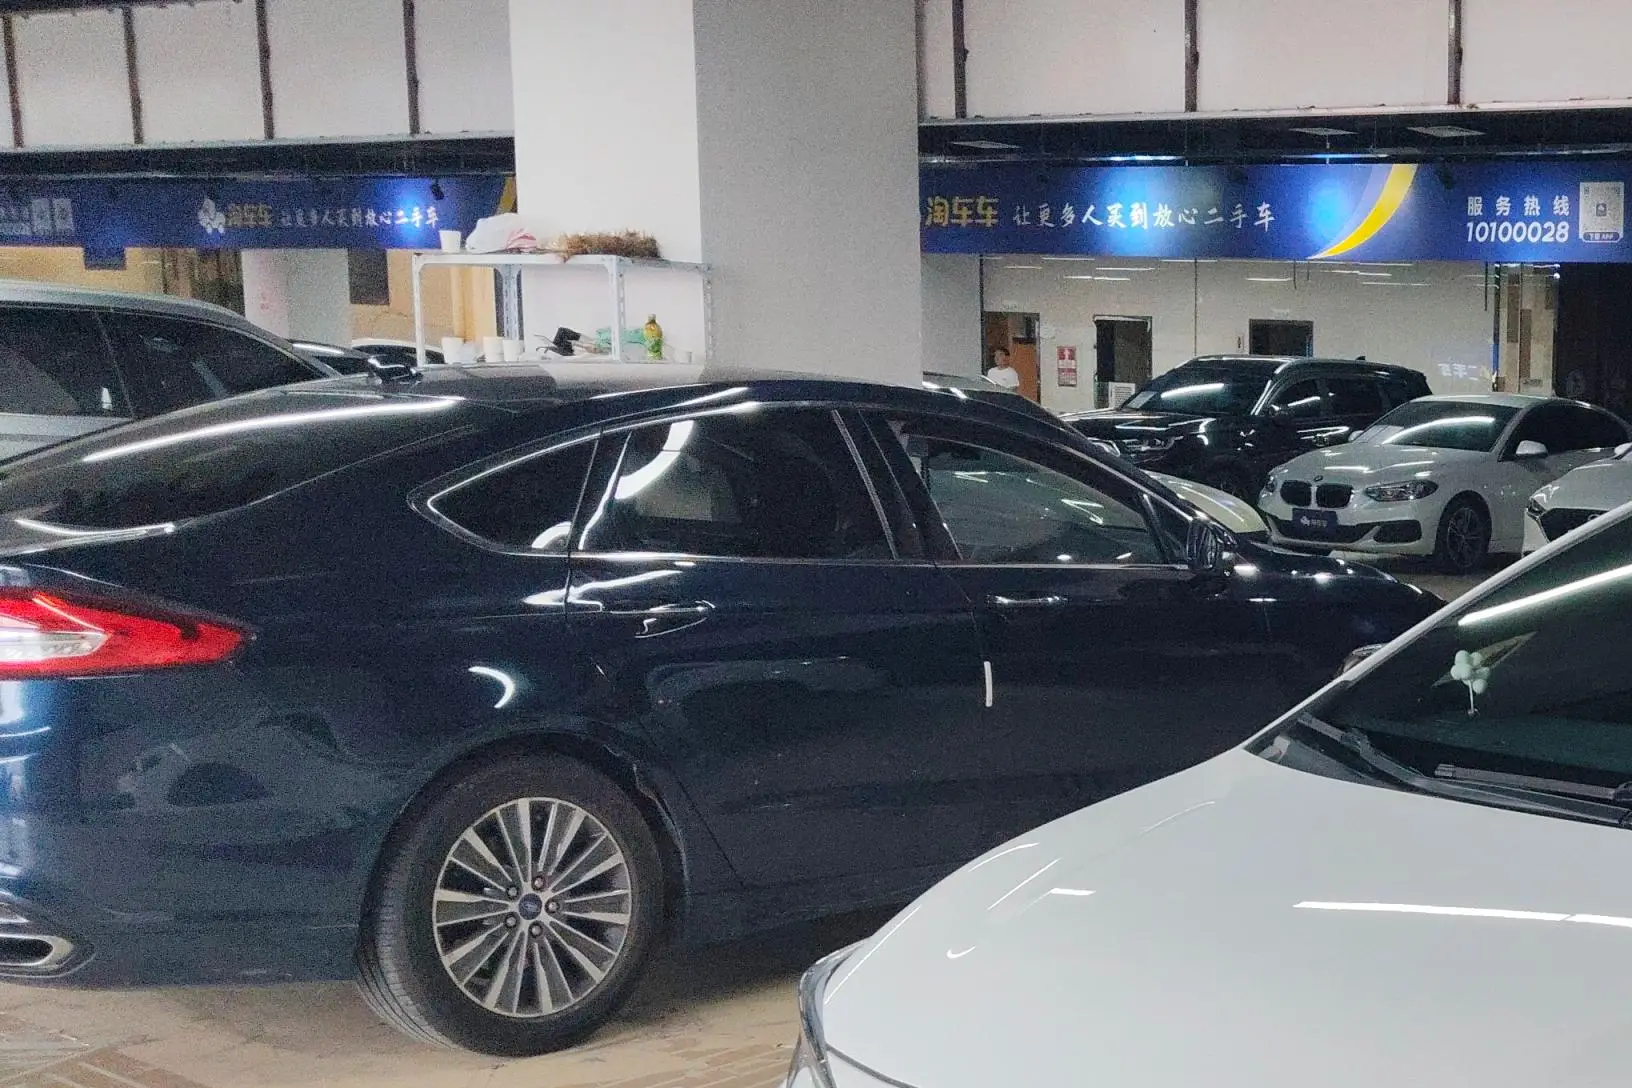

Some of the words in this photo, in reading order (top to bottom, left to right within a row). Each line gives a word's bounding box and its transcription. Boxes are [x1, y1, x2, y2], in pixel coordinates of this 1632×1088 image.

[925, 196, 999, 227] 淘车车
[1012, 202, 1274, 232] 让更多人买到放心二手车
[1467, 195, 1570, 217] 服务热线
[1467, 221, 1570, 243] 10100028
